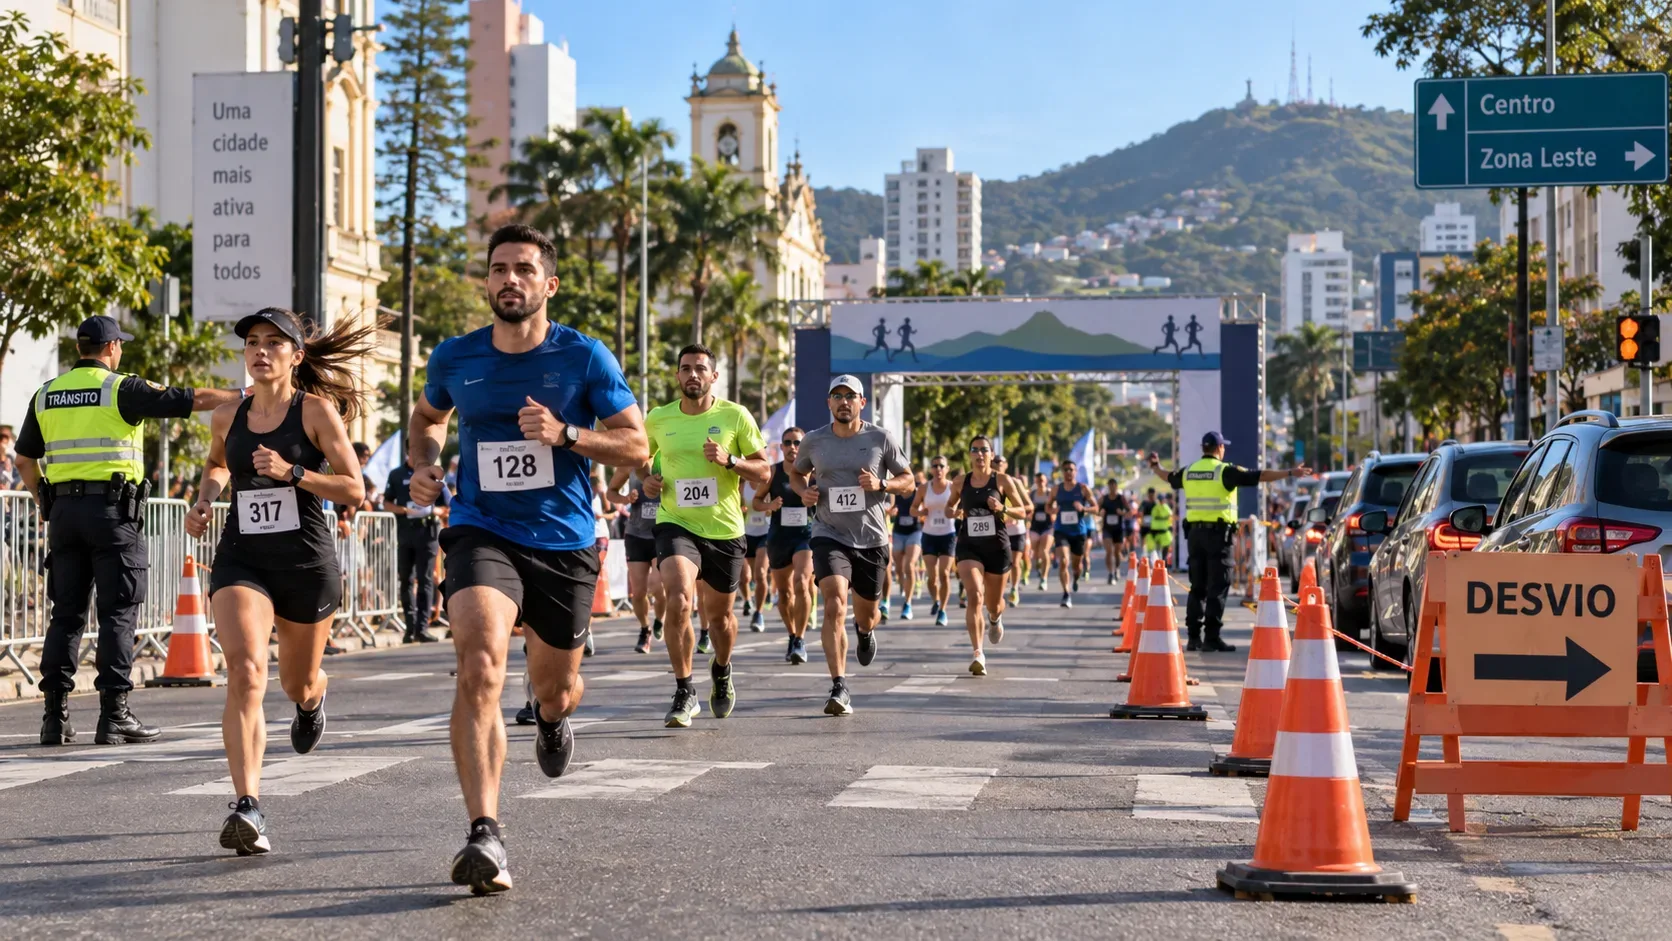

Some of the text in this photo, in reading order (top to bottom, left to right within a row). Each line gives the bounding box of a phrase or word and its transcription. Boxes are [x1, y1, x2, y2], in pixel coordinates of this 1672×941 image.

[213, 102, 251, 120] Uma
[1480, 94, 1555, 115] Centro
[213, 132, 268, 152] cidade
[1480, 147, 1597, 169] Zona Leste
[213, 165, 252, 184] mais
[213, 198, 254, 216] ativa
[213, 233, 250, 252] para
[213, 261, 261, 280] todos
[48, 390, 98, 406] TRÁNSITO
[493, 454, 537, 478] 128
[684, 486, 709, 501] 204
[836, 493, 857, 506] 412
[250, 500, 282, 523] 317
[973, 522, 990, 532] 289
[1467, 581, 1615, 618] DESVIO
